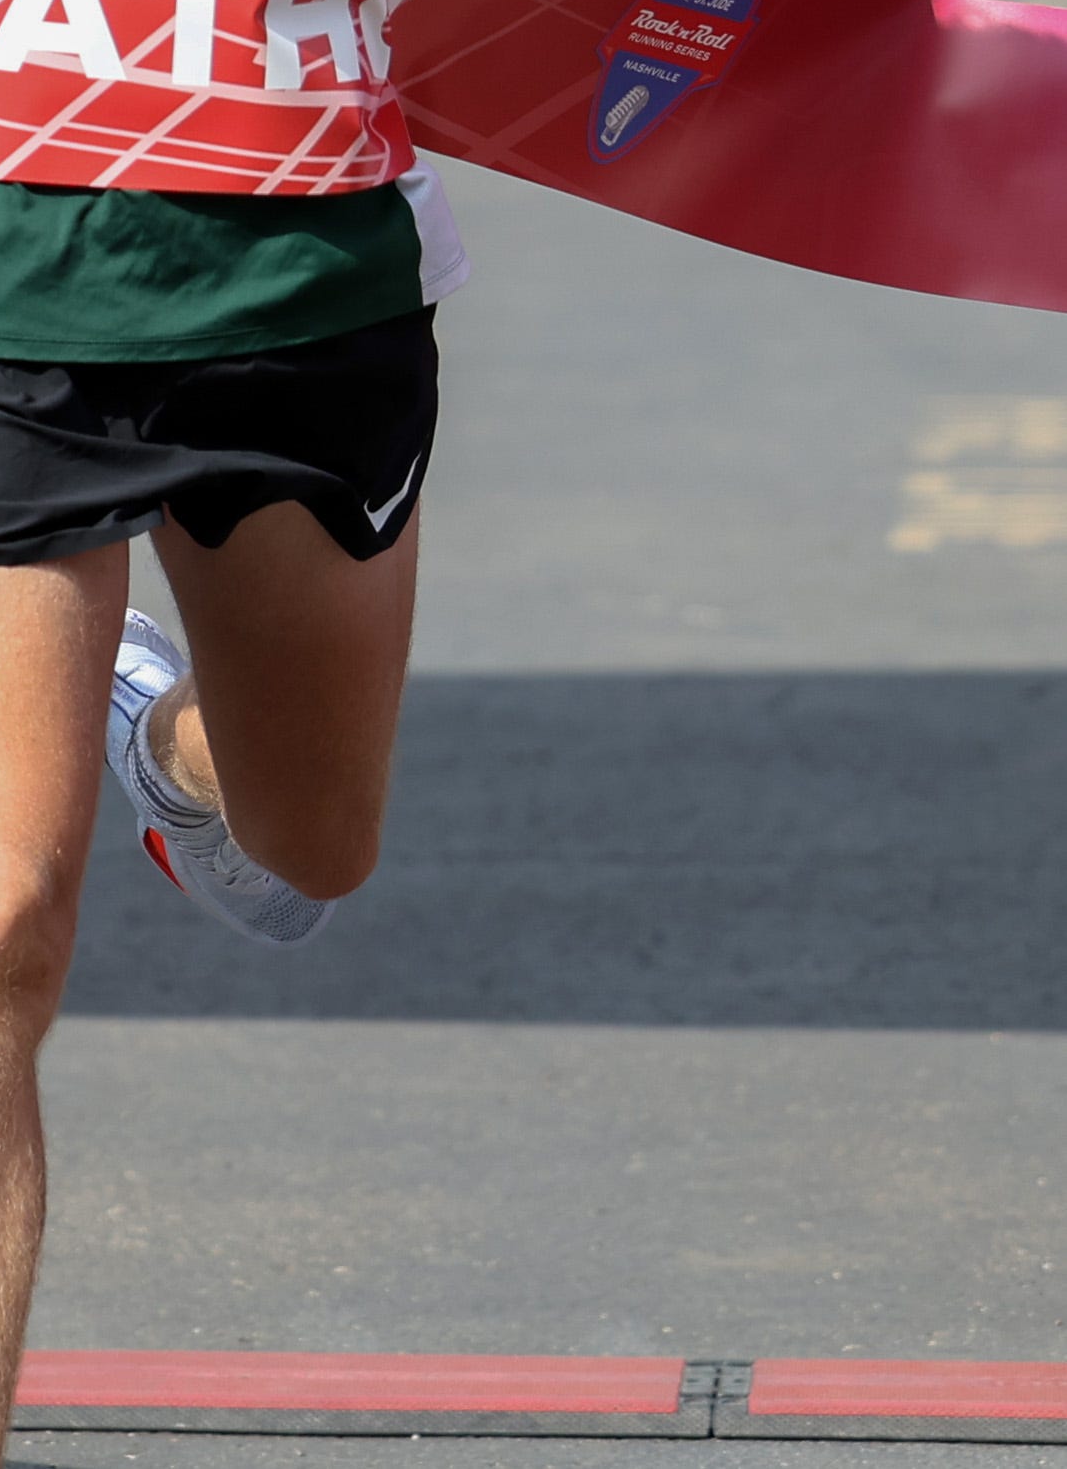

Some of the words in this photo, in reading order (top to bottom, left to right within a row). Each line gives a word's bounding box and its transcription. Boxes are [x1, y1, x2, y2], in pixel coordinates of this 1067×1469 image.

[630, 9, 681, 37] Rock
[689, 24, 736, 50] Roll
[628, 32, 674, 51] RUNNING
[673, 43, 711, 62] SERIES
[623, 59, 681, 83] NASHVILLE
